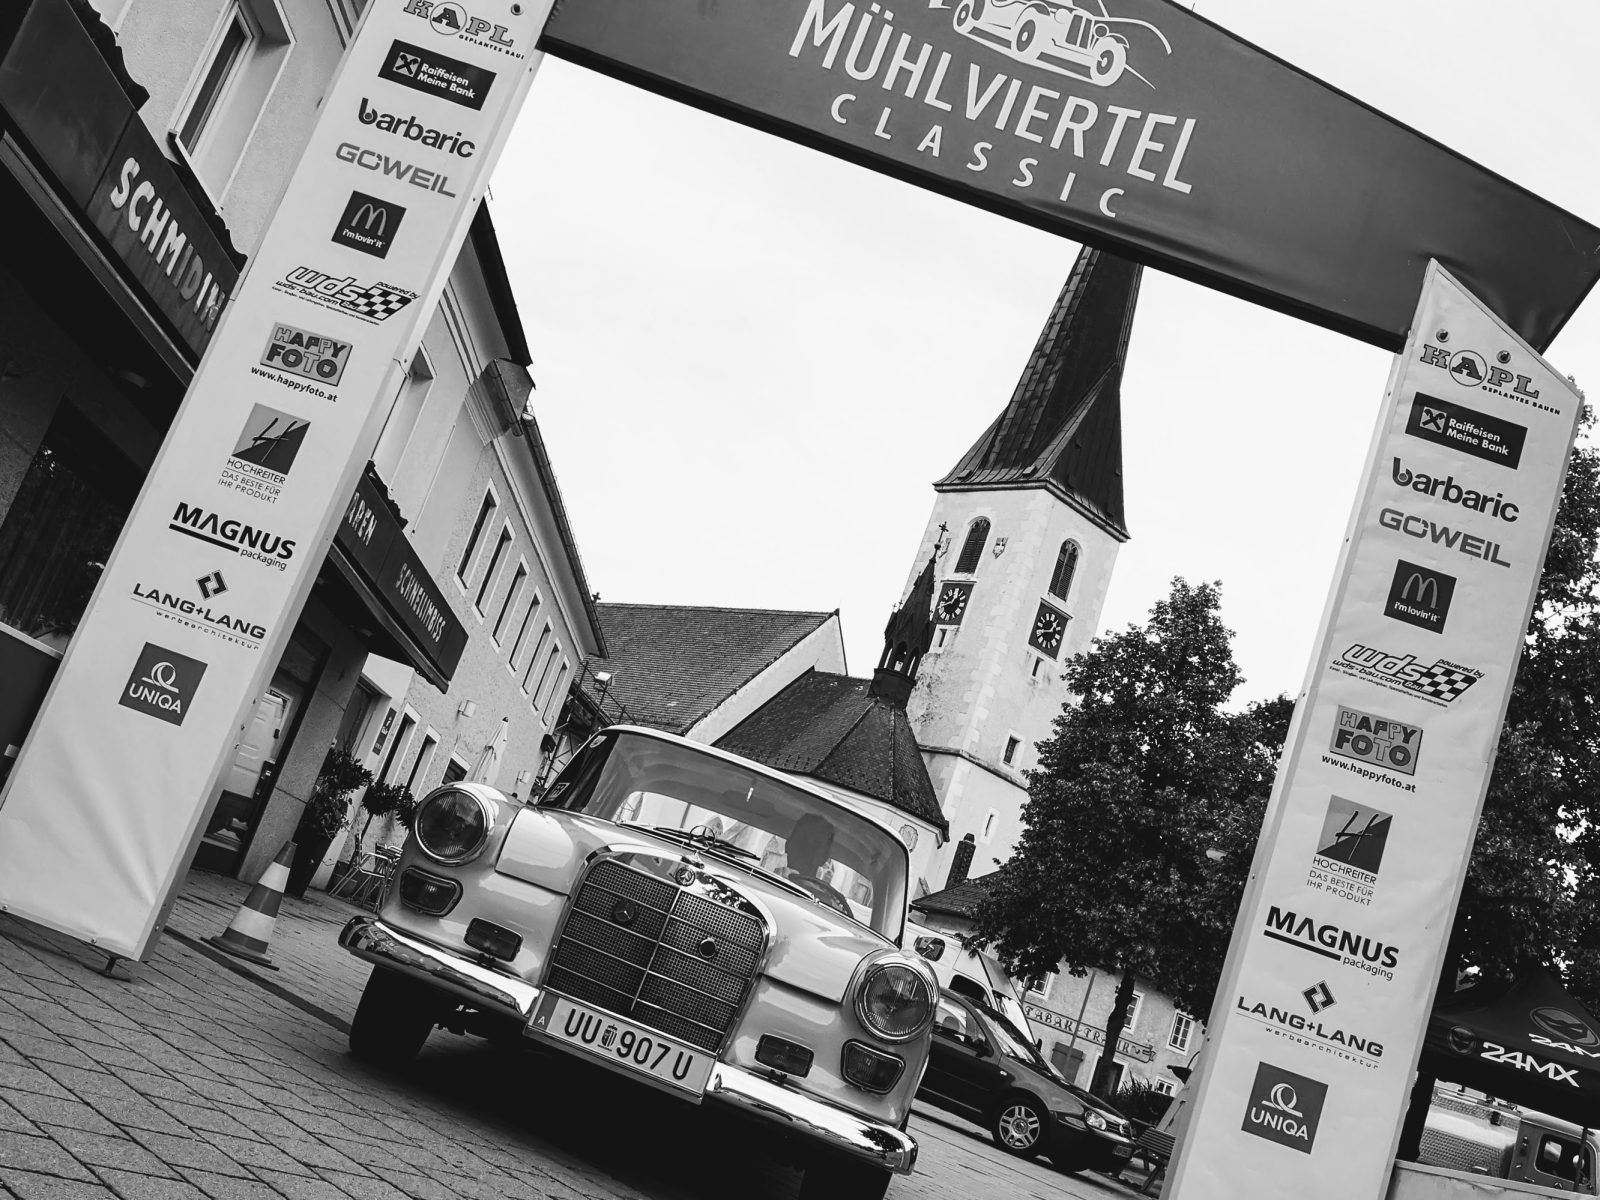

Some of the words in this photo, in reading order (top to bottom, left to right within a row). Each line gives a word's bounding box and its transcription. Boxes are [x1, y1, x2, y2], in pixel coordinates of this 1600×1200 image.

[403, 0, 514, 47] KAPL
[459, 34, 502, 53] GEPLANTES
[417, 72, 447, 89] Meine
[449, 83, 476, 99] Bank
[421, 63, 469, 86] Raiffeisen
[788, 0, 1197, 194] MÜHLVIERTEL
[358, 97, 476, 158] barbaric
[830, 92, 1125, 219] CLASSIC
[285, 266, 372, 303] wds
[376, 281, 410, 296] powered
[407, 288, 421, 300] by
[265, 342, 338, 378] FOTO
[274, 327, 348, 359] HAPPY
[251, 366, 338, 402] www.happyfoto.at
[1420, 343, 1540, 399] KAPL
[1481, 385, 1530, 406] GEPLANTES
[1531, 400, 1561, 416] BAUEN
[1446, 428, 1479, 446] Meine
[1481, 440, 1509, 456] Bank
[1449, 418, 1501, 442] Raiffeisen
[221, 470, 239, 482] DAS
[240, 475, 263, 491] BESTE
[264, 483, 281, 497] FÜR
[226, 458, 286, 485] HOCHREITER
[217, 478, 234, 489] IHR
[235, 483, 278, 504] PRODUKT
[1392, 456, 1520, 523] barbaric
[172, 502, 297, 560] MAGNUS
[240, 547, 288, 572] packaging
[132, 583, 267, 639] LANG+LANG
[156, 610, 259, 651] werbearchitektur
[1341, 643, 1432, 683] wds
[1438, 658, 1473, 674] powered
[1472, 666, 1485, 679] by
[128, 683, 182, 714] UNIQA
[1339, 711, 1418, 745] HAPPY
[1334, 728, 1411, 767] FOTO
[1321, 754, 1417, 793] www.happyfoto.at
[1309, 869, 1328, 883] DAS
[1330, 876, 1355, 892] BESTE
[1356, 884, 1374, 898] FÜR
[1312, 856, 1377, 885] HOCHREITER
[1306, 878, 1322, 891] IHR
[1325, 884, 1372, 907] PRODUKT
[1265, 905, 1400, 969] MAGNUS
[1342, 955, 1394, 982] packaging
[537, 1016, 545, 1026] A
[1237, 996, 1385, 1058] LANG+LANG
[564, 1008, 603, 1044] UU
[616, 1030, 672, 1070] 907
[672, 1051, 694, 1080] U
[1265, 1026, 1379, 1070] werbearchitektur
[1480, 1041, 1580, 1088] 24MX
[1250, 1106, 1309, 1141] UNIQA
